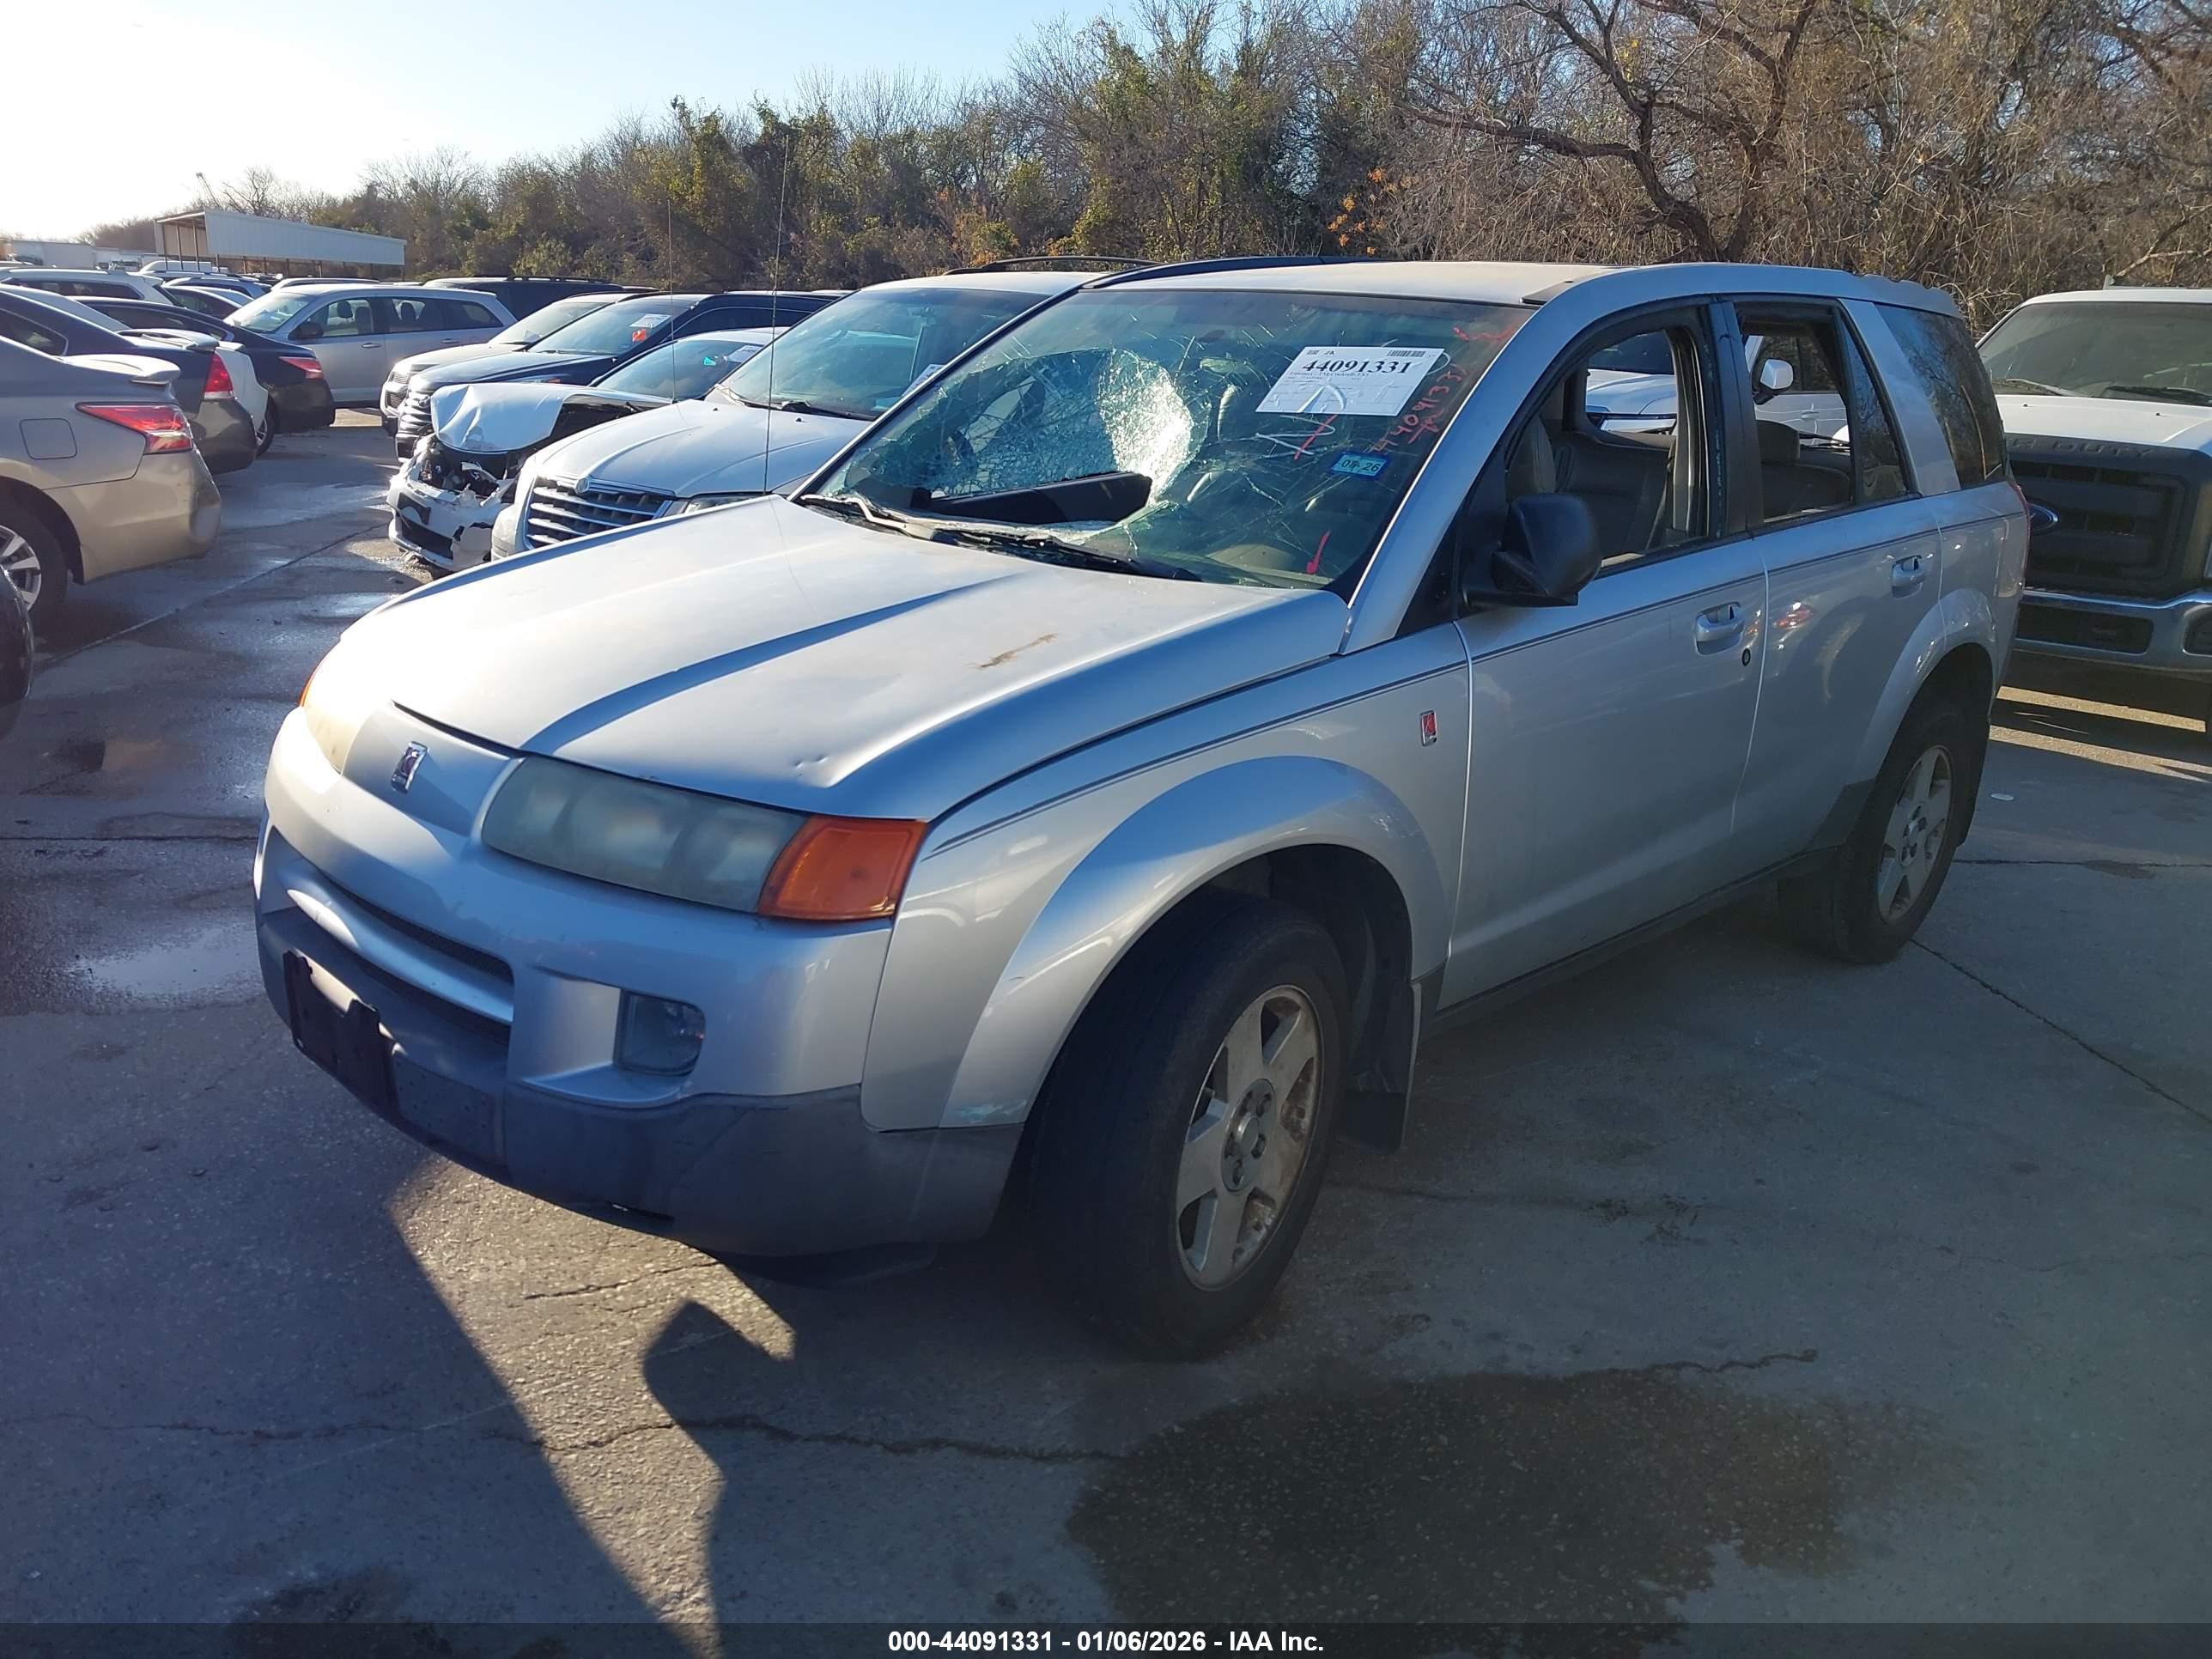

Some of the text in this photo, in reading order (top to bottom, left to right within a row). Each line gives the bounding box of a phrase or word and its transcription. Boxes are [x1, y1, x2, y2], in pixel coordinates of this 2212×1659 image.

[1302, 359, 1413, 374] 44091331
[2052, 440, 2155, 458] DUTY
[1361, 462, 1382, 472] 26
